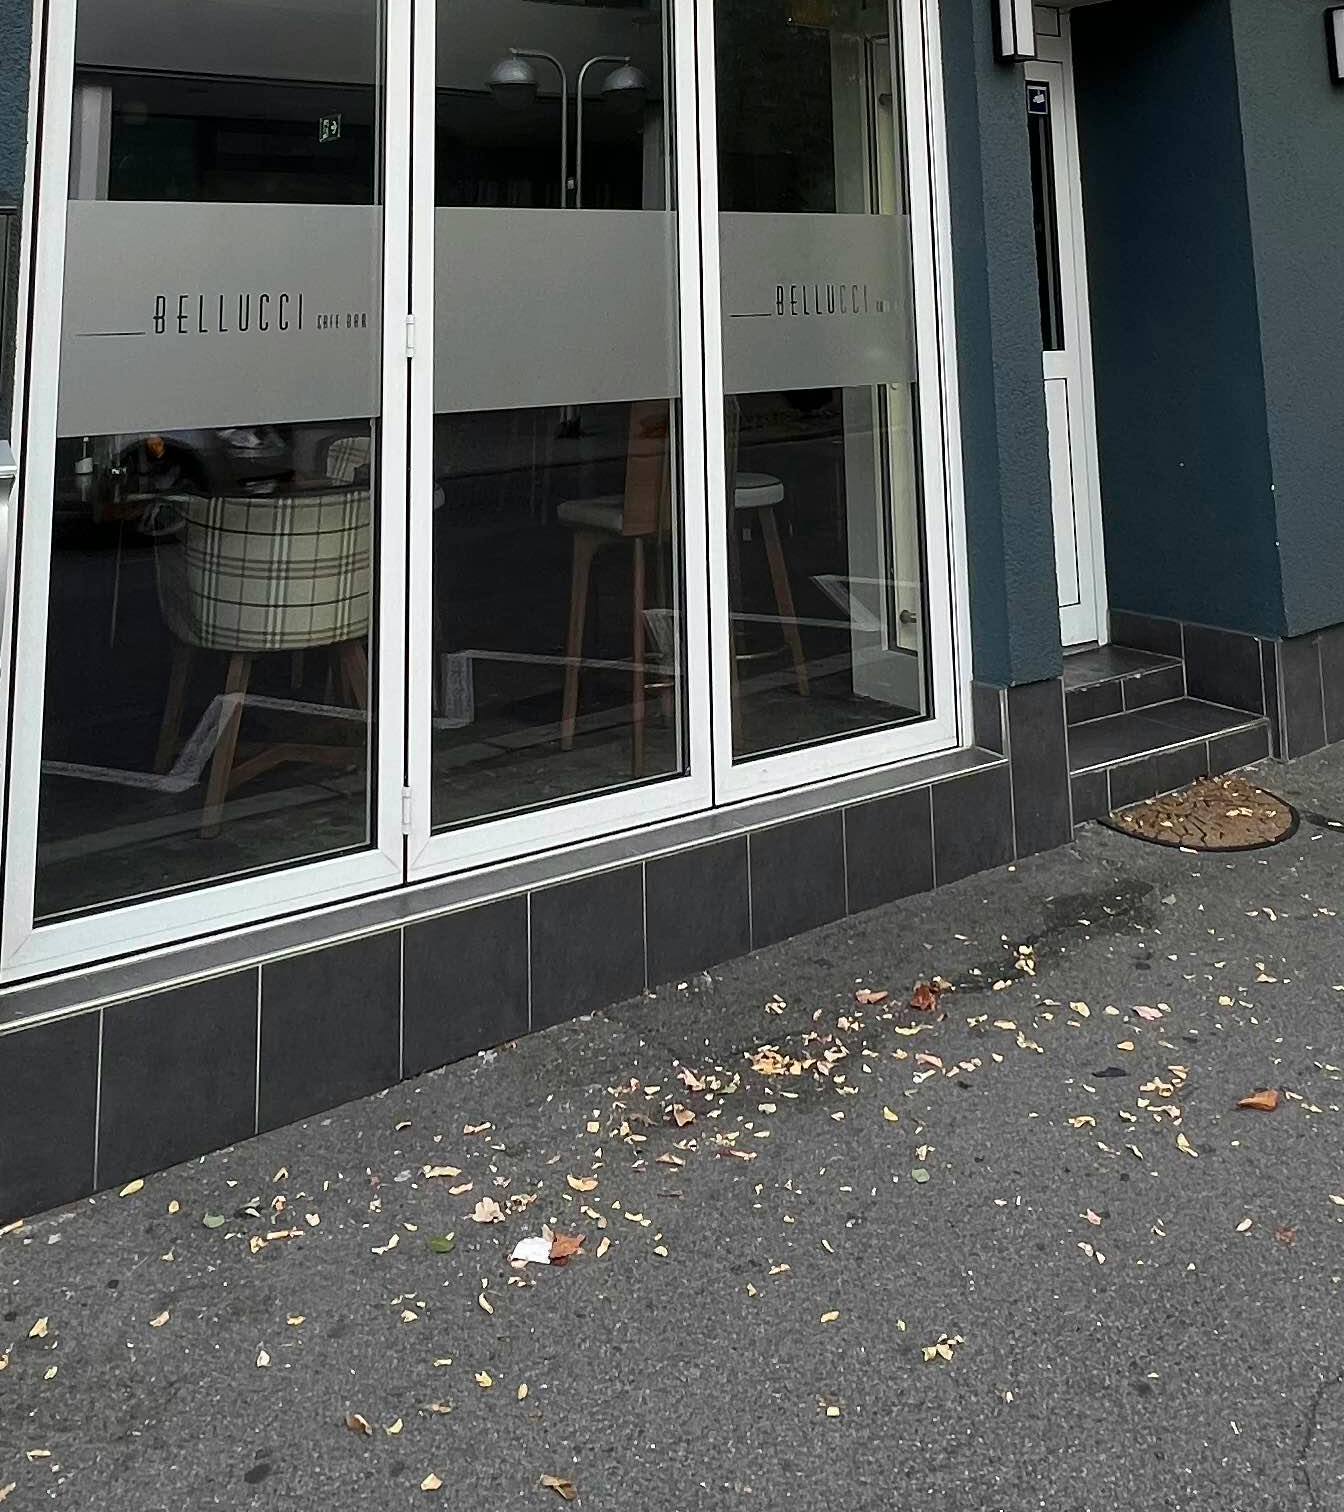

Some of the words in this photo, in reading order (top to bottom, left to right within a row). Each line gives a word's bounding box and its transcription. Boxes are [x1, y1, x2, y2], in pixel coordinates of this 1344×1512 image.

[152, 293, 304, 335] BELLUCCI
[316, 313, 341, 330] CAFE
[346, 312, 368, 329] BAR
[775, 284, 870, 316] BELLUCCI
